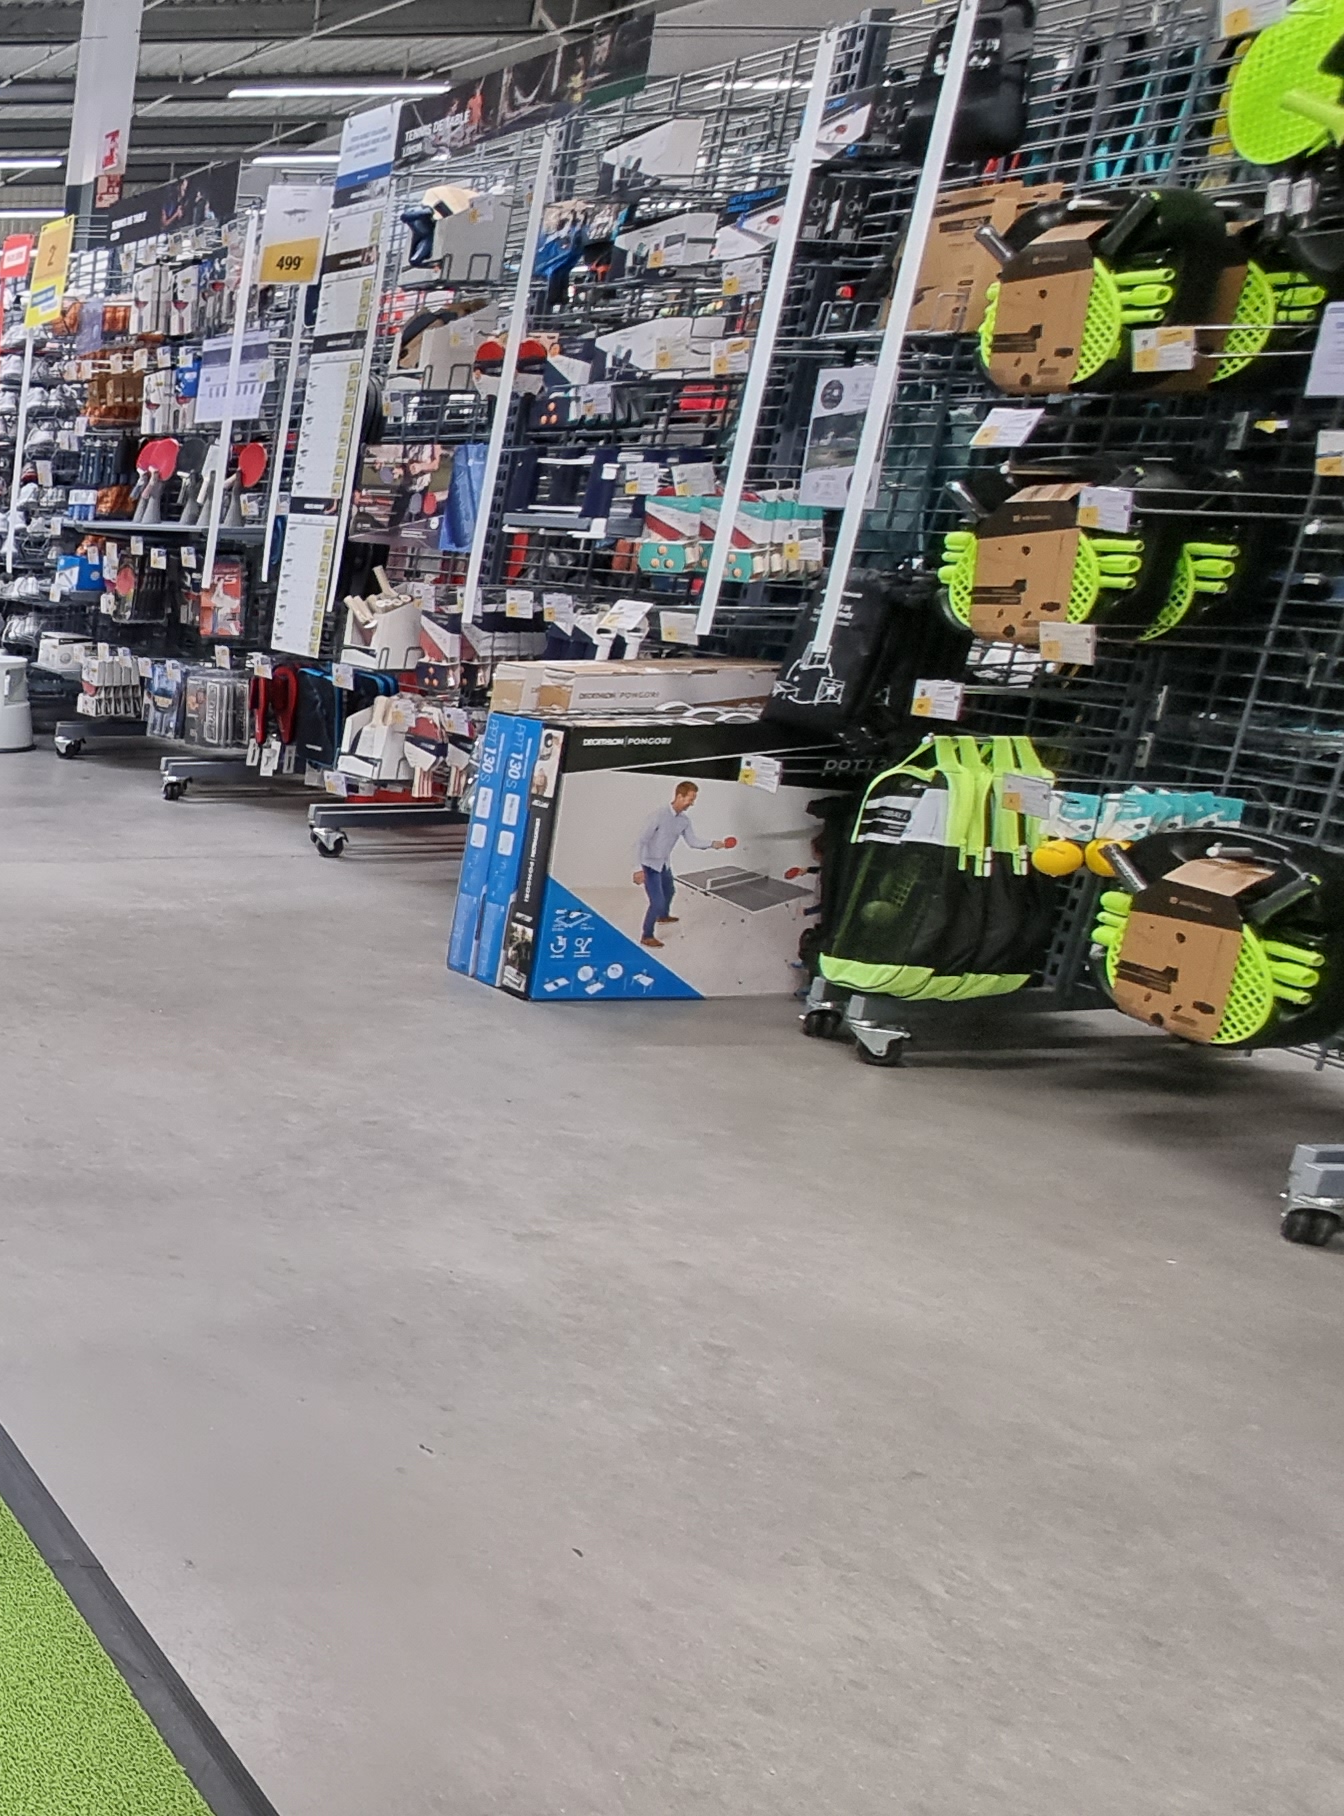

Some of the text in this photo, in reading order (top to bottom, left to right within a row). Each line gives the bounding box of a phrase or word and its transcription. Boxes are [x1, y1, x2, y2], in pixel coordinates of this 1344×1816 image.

[514, 722, 527, 750] PPT
[582, 737, 672, 746] DECATHLON PONGORI
